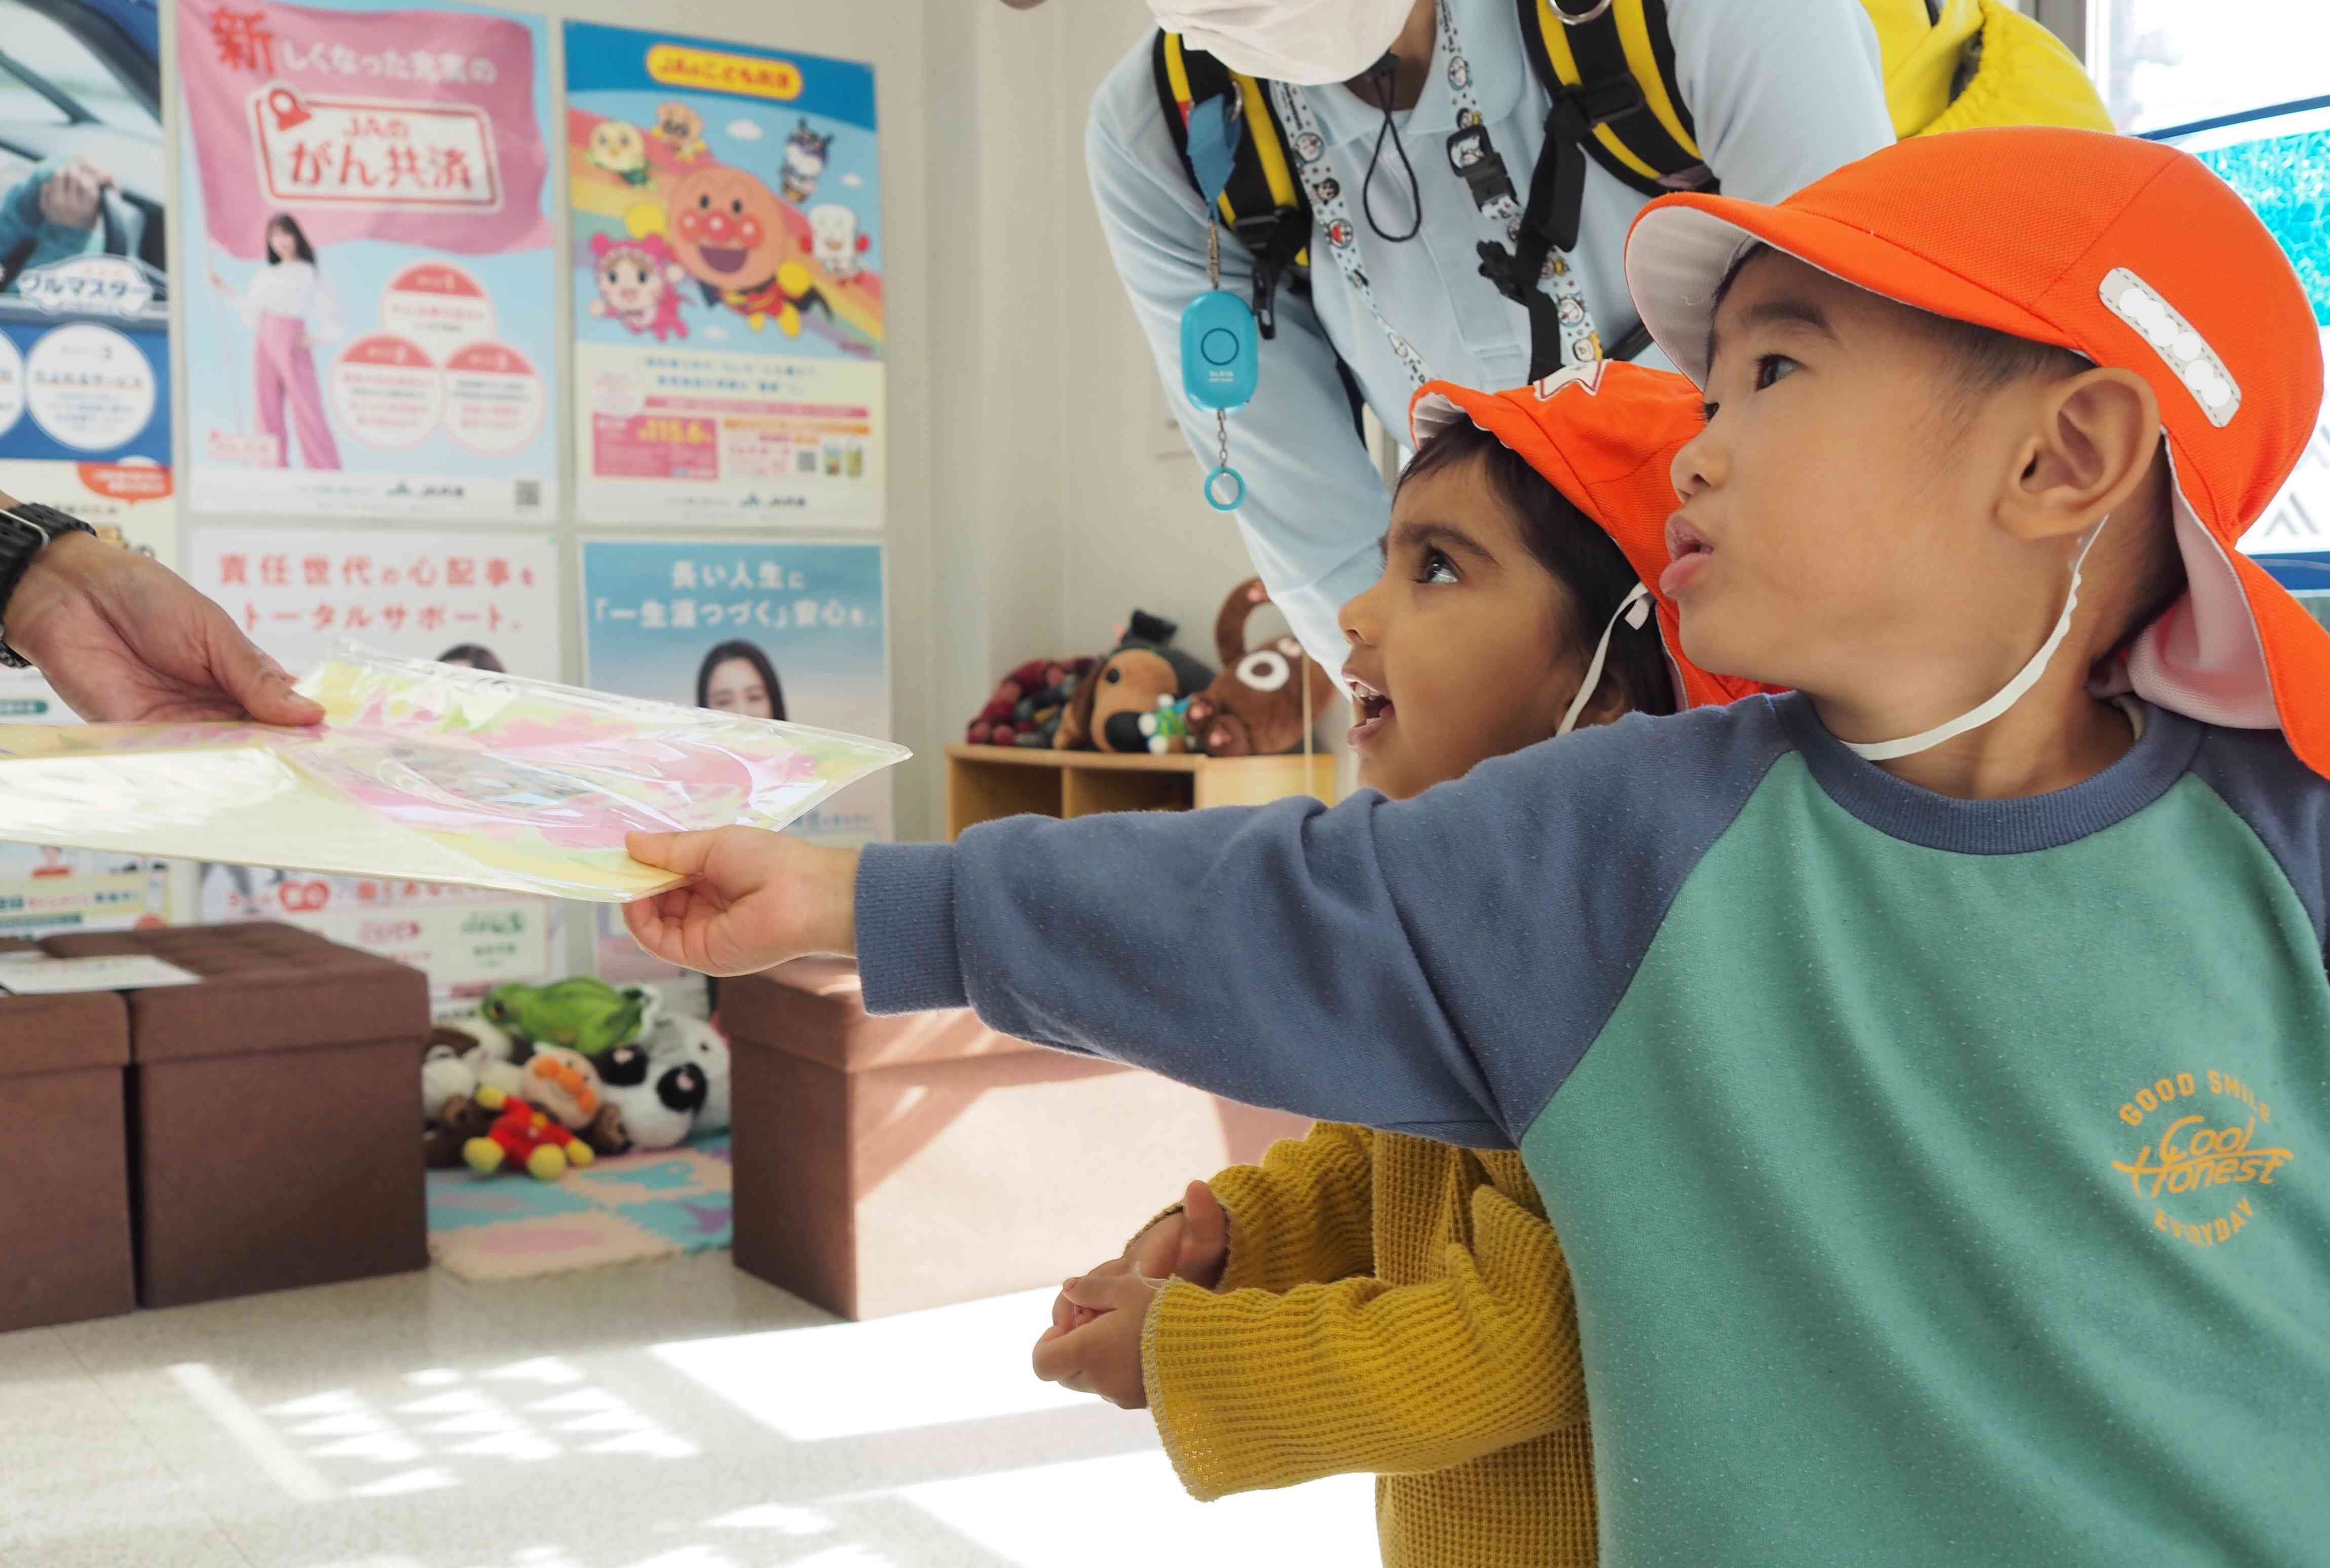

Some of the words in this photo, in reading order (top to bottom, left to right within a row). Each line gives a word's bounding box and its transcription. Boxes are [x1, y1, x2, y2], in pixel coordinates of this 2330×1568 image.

[343, 117, 409, 138] JAの
[290, 140, 473, 190] がん共済
[219, 554, 535, 587] 責任世代の心配事を
[671, 559, 804, 589] 長い人生に
[2119, 1072, 2196, 1127] GOOD
[2160, 1115, 2256, 1163] Cool
[2154, 1196, 2254, 1247] EVRYDAY
